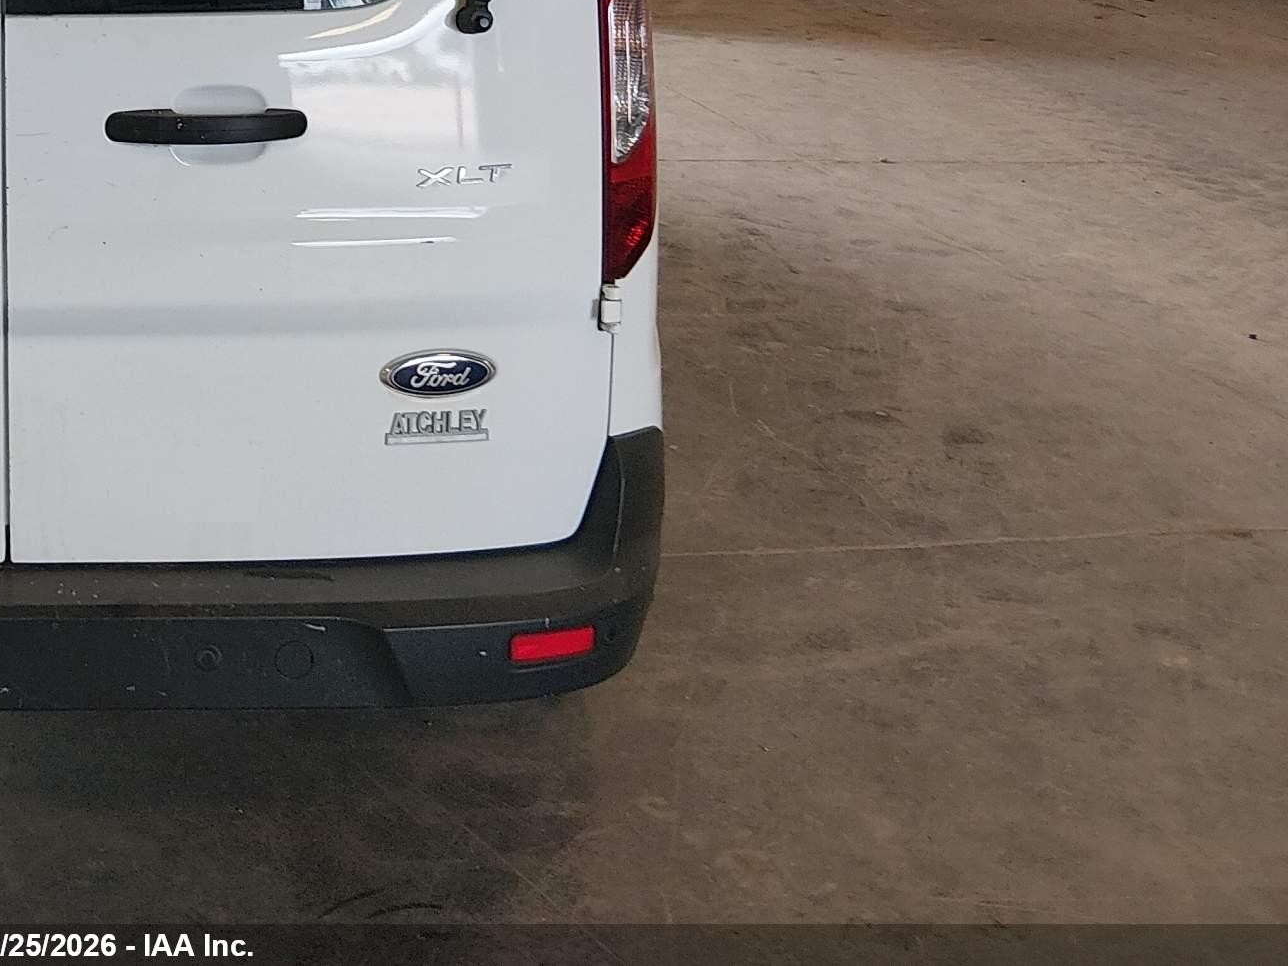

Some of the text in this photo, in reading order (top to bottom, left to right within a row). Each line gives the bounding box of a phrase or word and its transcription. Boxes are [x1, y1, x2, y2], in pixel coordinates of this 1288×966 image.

[415, 164, 513, 187] XLT
[410, 361, 472, 388] Ford
[389, 408, 487, 435] ATCHLEY
